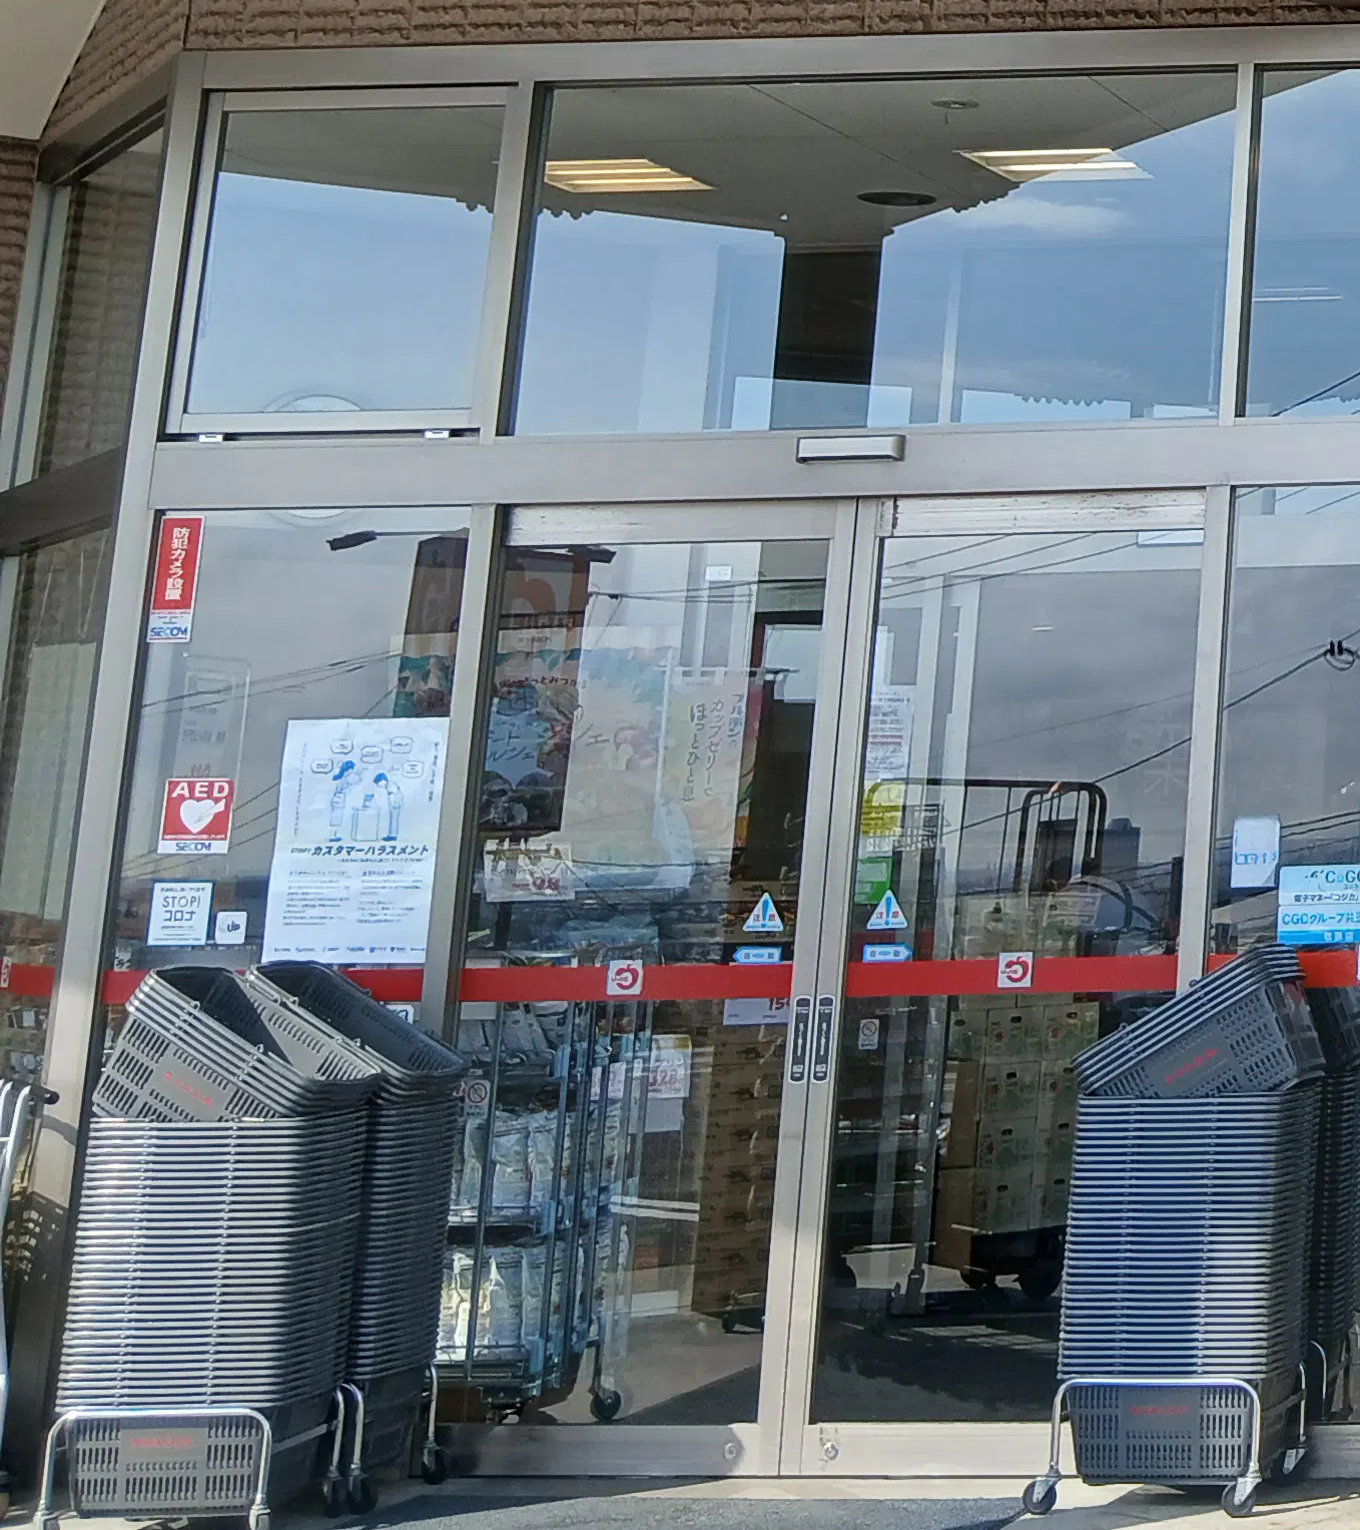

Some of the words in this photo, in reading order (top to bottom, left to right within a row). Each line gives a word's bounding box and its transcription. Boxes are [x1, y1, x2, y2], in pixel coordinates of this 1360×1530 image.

[164, 527, 190, 601] 防犯カメラ設置
[150, 627, 188, 638] SECOM
[171, 782, 230, 798] AED
[175, 841, 212, 852] SECOM
[311, 844, 429, 857] カスタマーハラスメント
[162, 895, 201, 909] STOP!
[163, 909, 197, 922] コロナ
